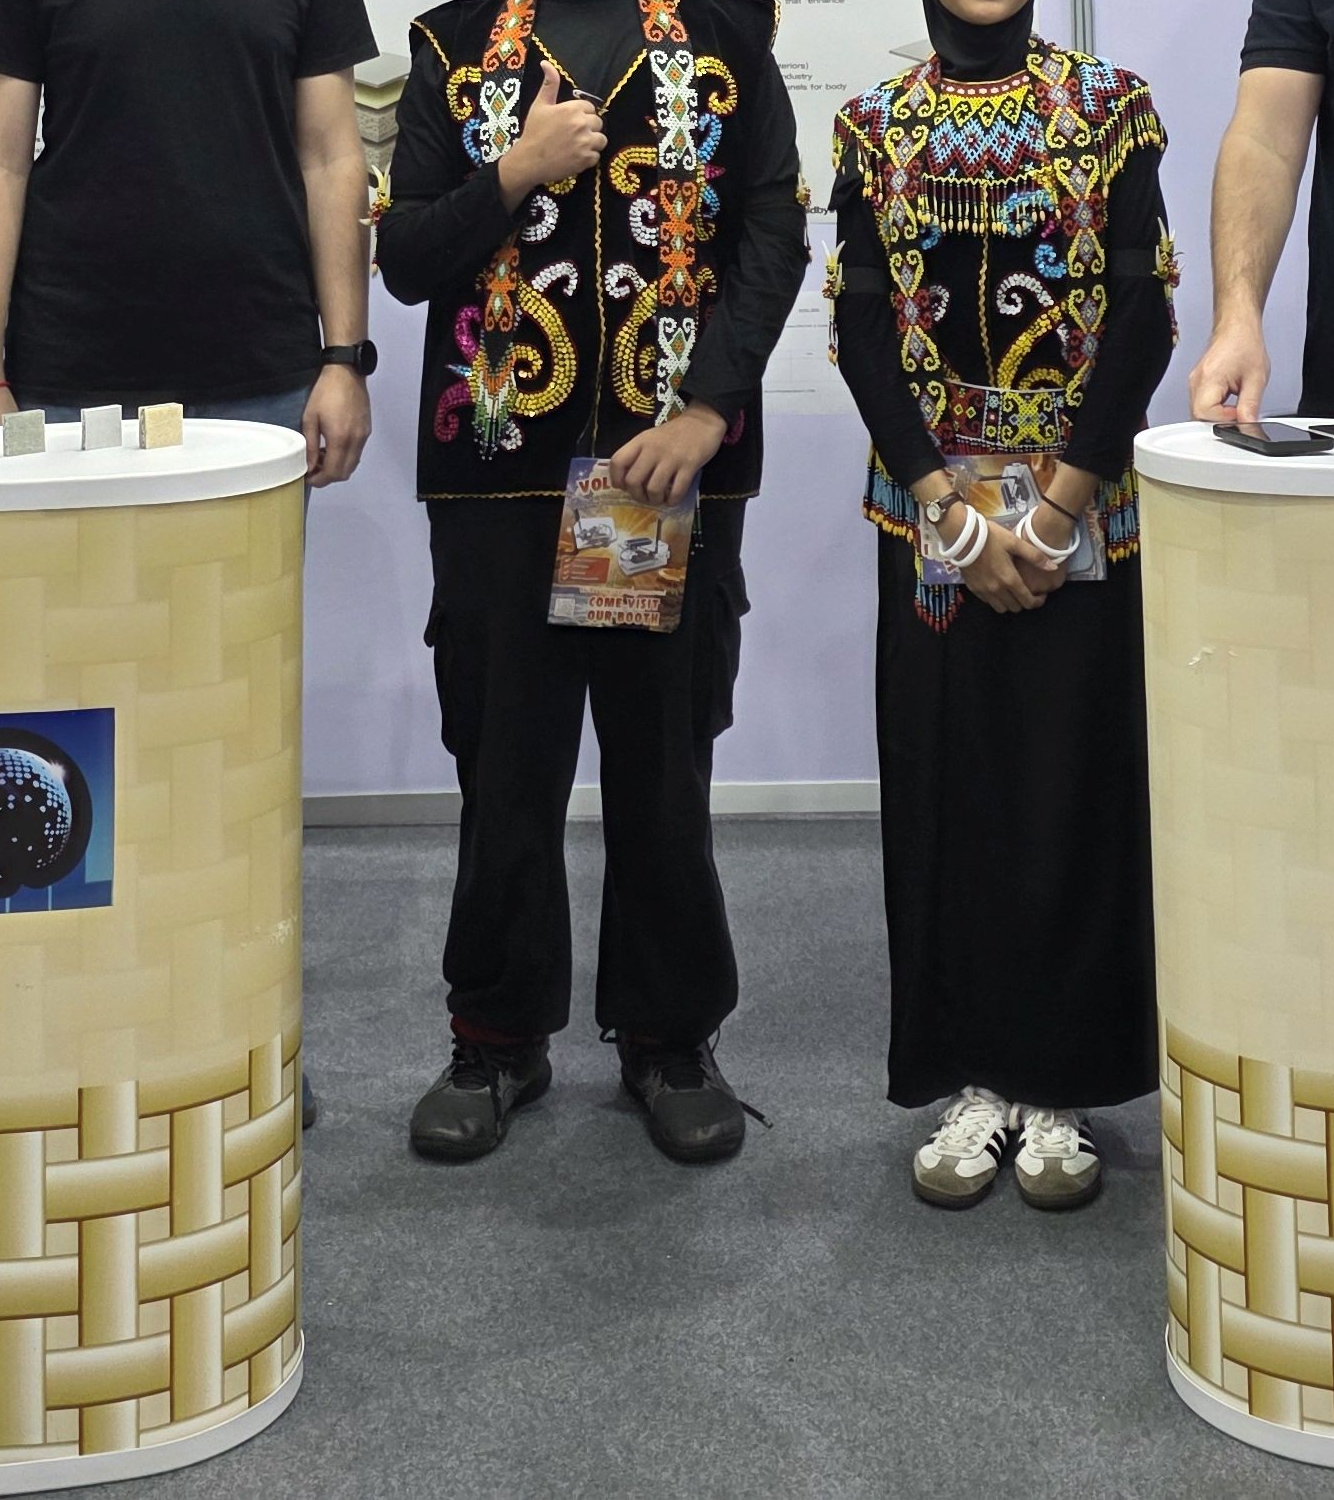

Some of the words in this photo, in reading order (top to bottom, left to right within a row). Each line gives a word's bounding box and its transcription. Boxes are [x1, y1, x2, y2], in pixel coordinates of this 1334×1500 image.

[826, 83, 847, 91] body
[588, 596, 622, 609] COME
[628, 597, 660, 611] VISIT
[587, 610, 612, 622] OUR
[617, 611, 660, 625] BOOTH
